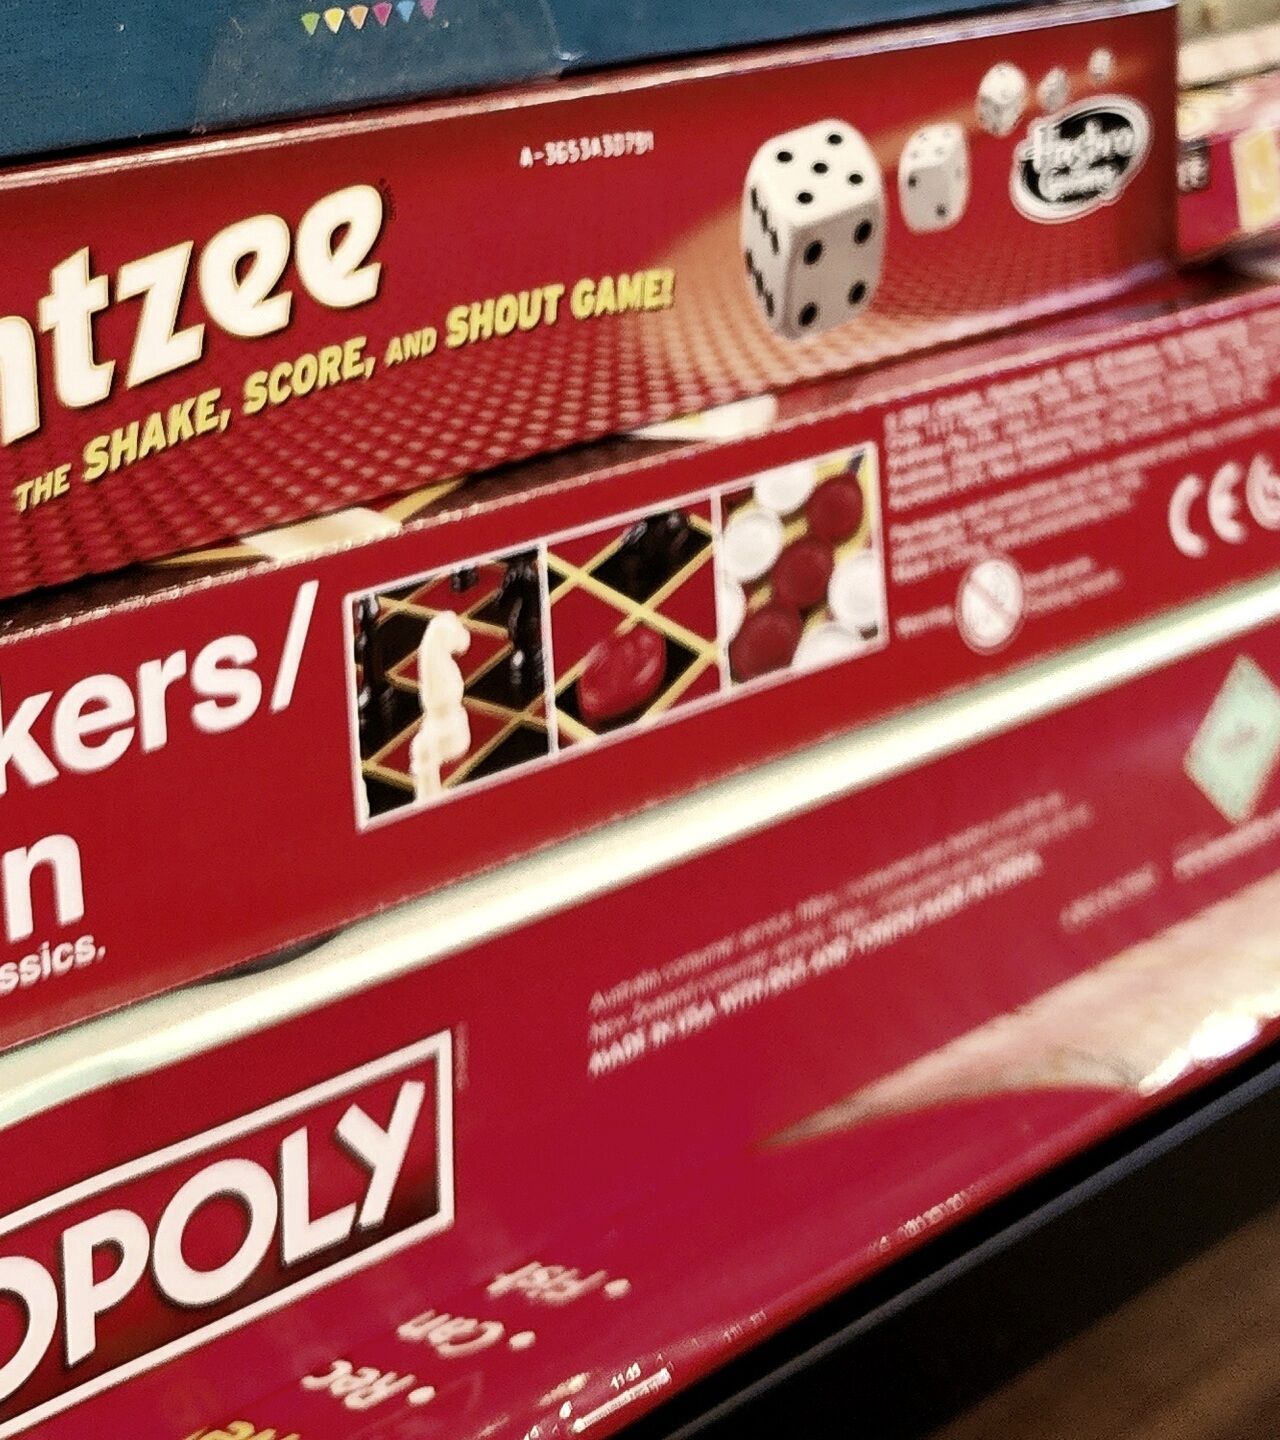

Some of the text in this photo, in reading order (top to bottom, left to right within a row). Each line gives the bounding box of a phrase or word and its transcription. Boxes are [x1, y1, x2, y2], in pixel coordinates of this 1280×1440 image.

[13, 267, 674, 513] THE SHAKE, SCORE, AND SHOUT GAME!
